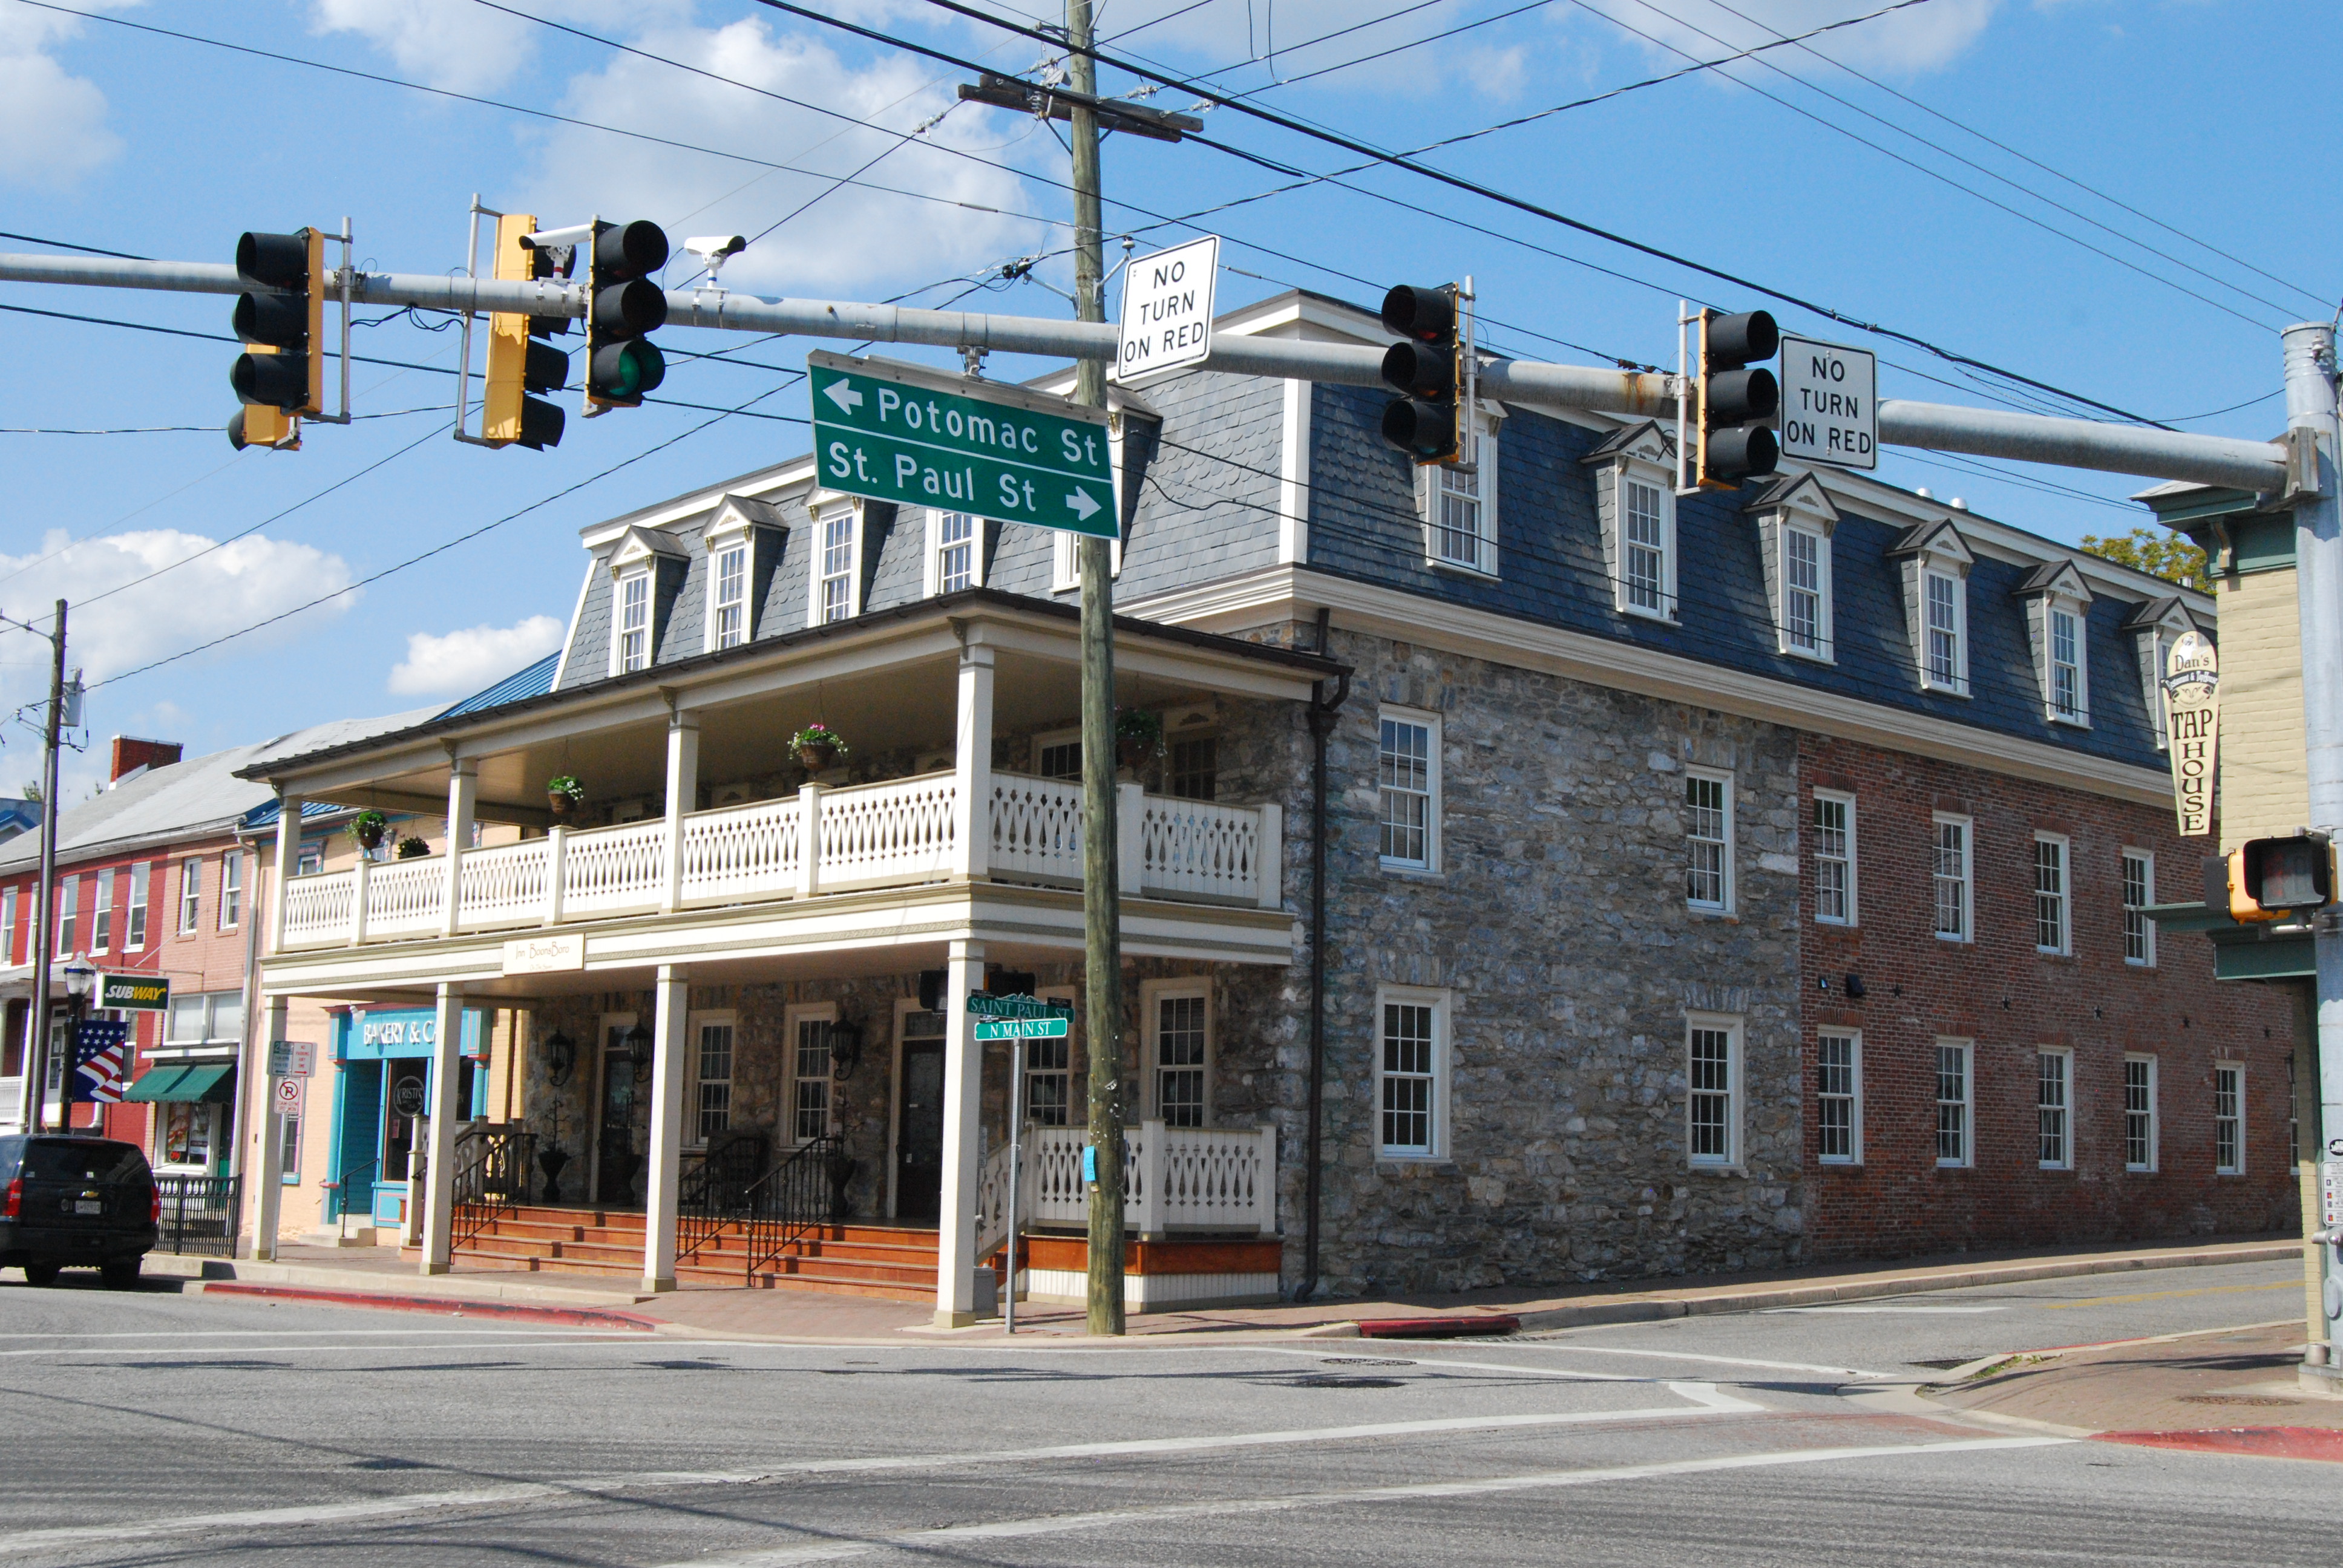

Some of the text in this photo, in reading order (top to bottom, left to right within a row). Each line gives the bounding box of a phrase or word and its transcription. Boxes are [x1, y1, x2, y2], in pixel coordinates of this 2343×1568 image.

[1153, 261, 1185, 289] NO
[1141, 290, 1194, 325] TURN
[1125, 322, 1204, 362] ON RED
[1812, 356, 1845, 382] NO
[1800, 388, 1858, 419] TURN
[878, 388, 1098, 466] Potomac St
[1787, 420, 1871, 454] ON RED
[828, 442, 1037, 512] St. Paul St
[2174, 655, 2210, 672] Dan's
[2171, 708, 2214, 740] TAP
[2181, 741, 2206, 831] HOUSE
[516, 944, 525, 960] Inn
[105, 985, 167, 1001] SUBWAY
[971, 999, 1070, 1019] SAINT PAUL ST
[364, 1020, 437, 1045] BAKERY & C
[990, 1022, 1052, 1038] N MAIN ST
